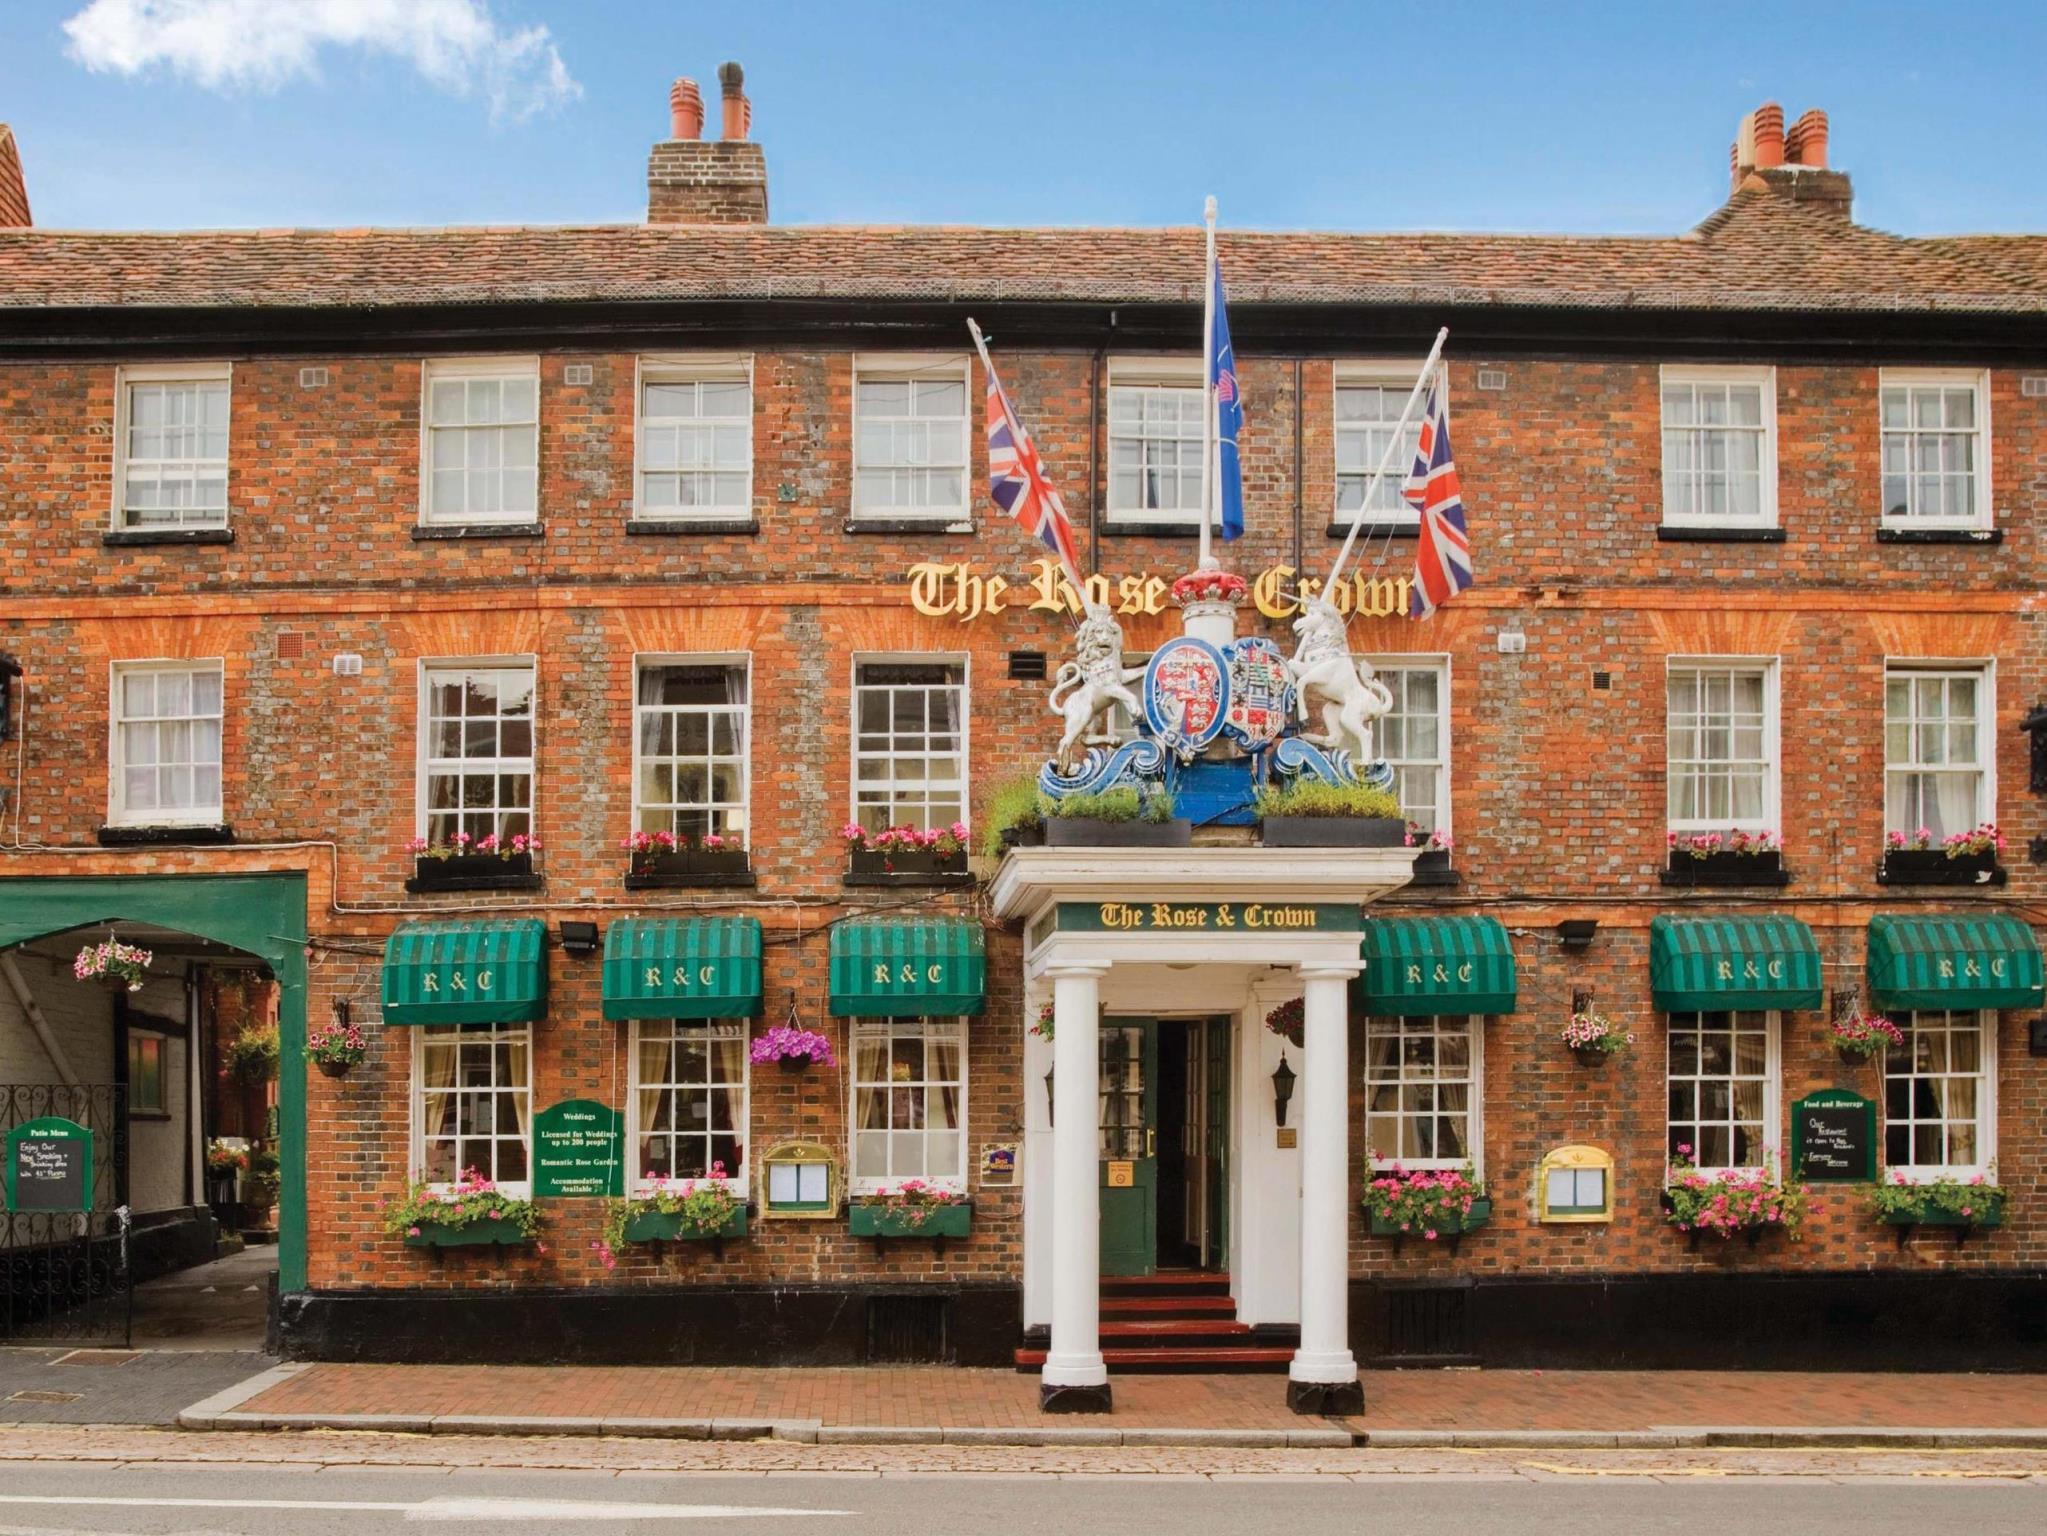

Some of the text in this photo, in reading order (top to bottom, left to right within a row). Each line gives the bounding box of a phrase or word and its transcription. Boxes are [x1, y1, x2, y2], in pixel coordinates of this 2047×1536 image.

[908, 562, 1008, 622] The
[1028, 559, 1167, 616] Rose
[1101, 903, 1316, 930] The Rose & Crown
[874, 964, 943, 984] R & C
[1406, 961, 1473, 983] R & C
[1718, 960, 1783, 979] R & C
[1940, 958, 2006, 977] R & C
[424, 970, 493, 992] R & C
[645, 966, 715, 987] R & C
[1835, 1100, 1864, 1109] Beverage
[563, 1112, 596, 1121] Weddings
[585, 1130, 618, 1139] Weddings
[20, 1141, 57, 1153] Enjoy Our
[571, 1138, 584, 1146] 200
[585, 1139, 608, 1147] people
[541, 1158, 619, 1166] Romantic Rose Garden
[551, 1177, 604, 1185] Accommodation
[561, 1185, 593, 1193] Available
